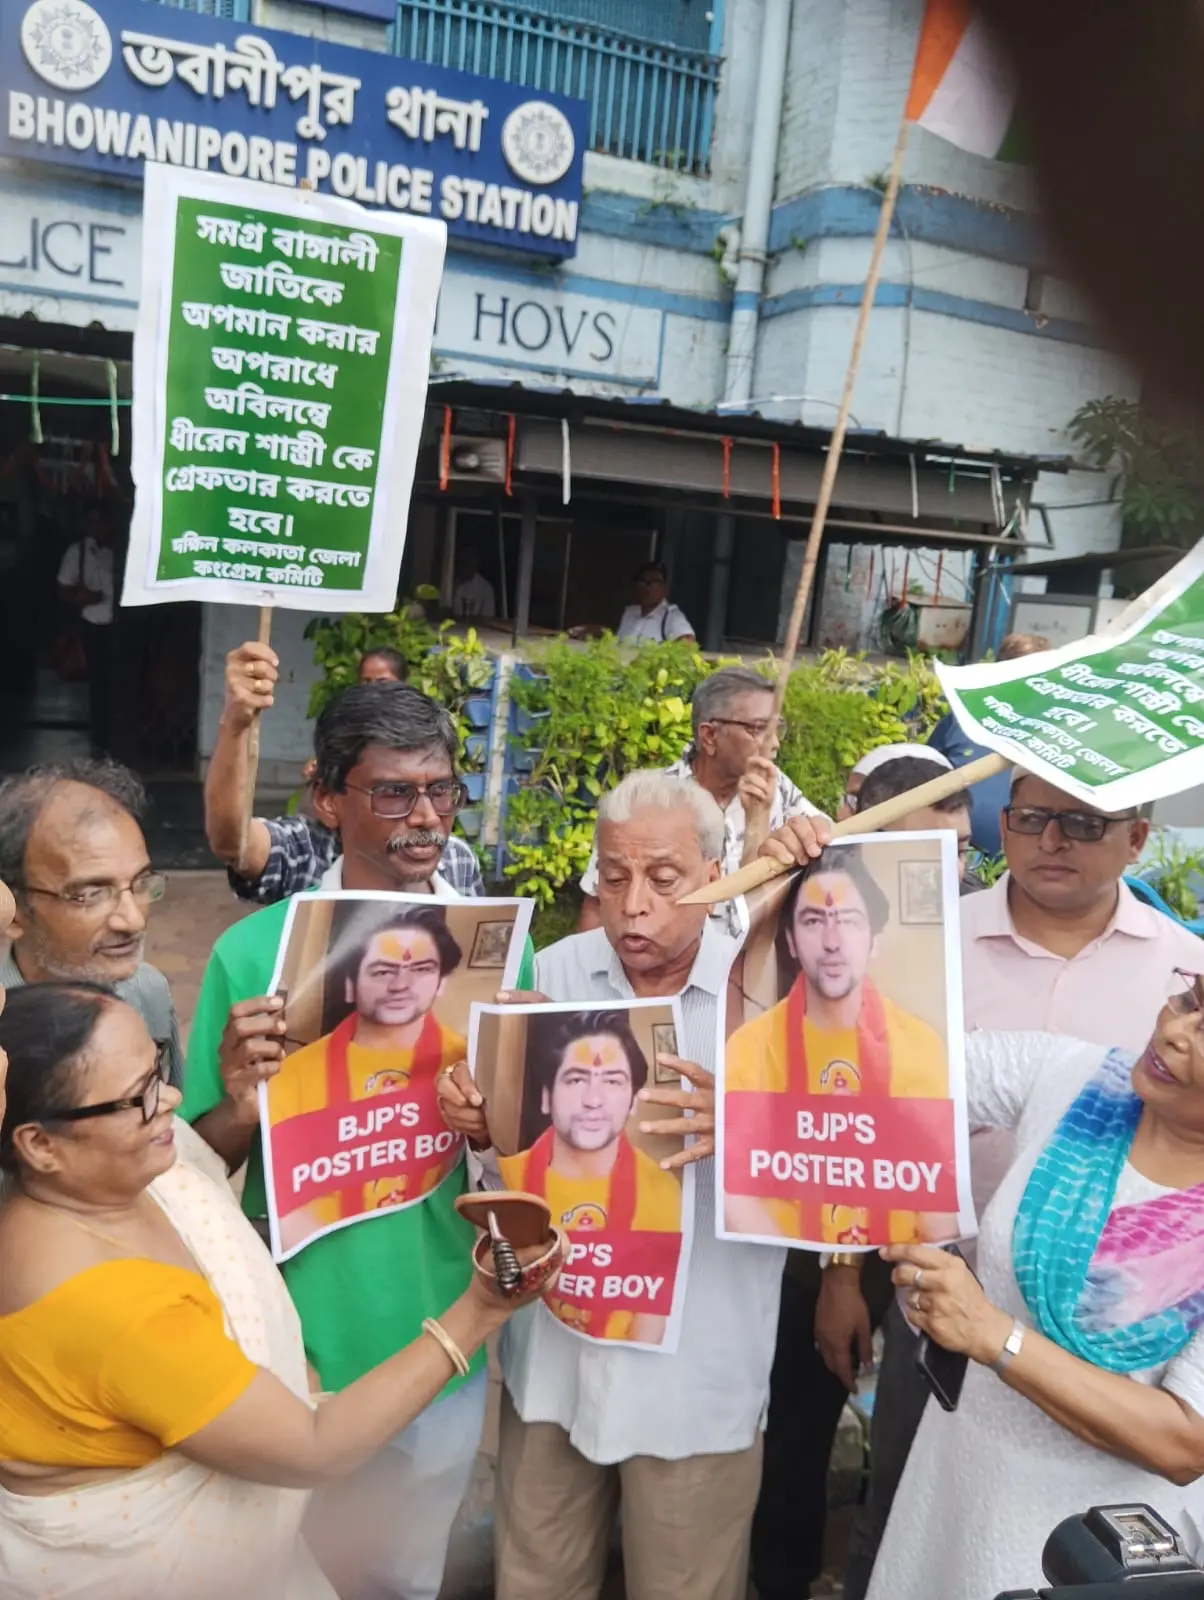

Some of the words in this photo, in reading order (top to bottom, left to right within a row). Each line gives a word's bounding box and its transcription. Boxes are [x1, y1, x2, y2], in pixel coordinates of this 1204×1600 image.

[121, 30, 361, 140] ভবানীপুর
[385, 86, 489, 151] থানা
[8, 90, 297, 187] BHOWANIPORE
[307, 148, 433, 213] POLICE
[440, 175, 578, 242] STATION
[196, 215, 267, 253] সমগ্র
[271, 232, 379, 272] বাঙ্গালী
[220, 260, 345, 307] জাতিকে
[181, 302, 292, 341] অপমান
[296, 318, 380, 356] করার
[473, 293, 616, 361] HOVS
[211, 346, 339, 389] অপরাধে
[204, 382, 332, 429] অবিলম্বে
[169, 416, 250, 455] ধীরেন
[255, 430, 327, 468] শাস্ত্রী
[332, 446, 375, 471] কে
[165, 465, 281, 498] গ্রেফতার
[286, 476, 372, 508] করতে
[227, 507, 294, 537] হবে।
[193, 560, 263, 581] কংগ্রেস
[265, 564, 324, 586] কমিটি
[222, 537, 306, 562] কলকাতা
[309, 549, 362, 567] জেলা
[338, 1102, 420, 1143] BJP'S
[796, 1111, 876, 1145] BJP'S
[292, 1137, 407, 1193] POSTER
[415, 1131, 460, 1159] BO
[750, 1149, 866, 1189] POSTER
[873, 1159, 942, 1194] BOY
[566, 1242, 613, 1267] P'S
[602, 1274, 664, 1300] BOY
